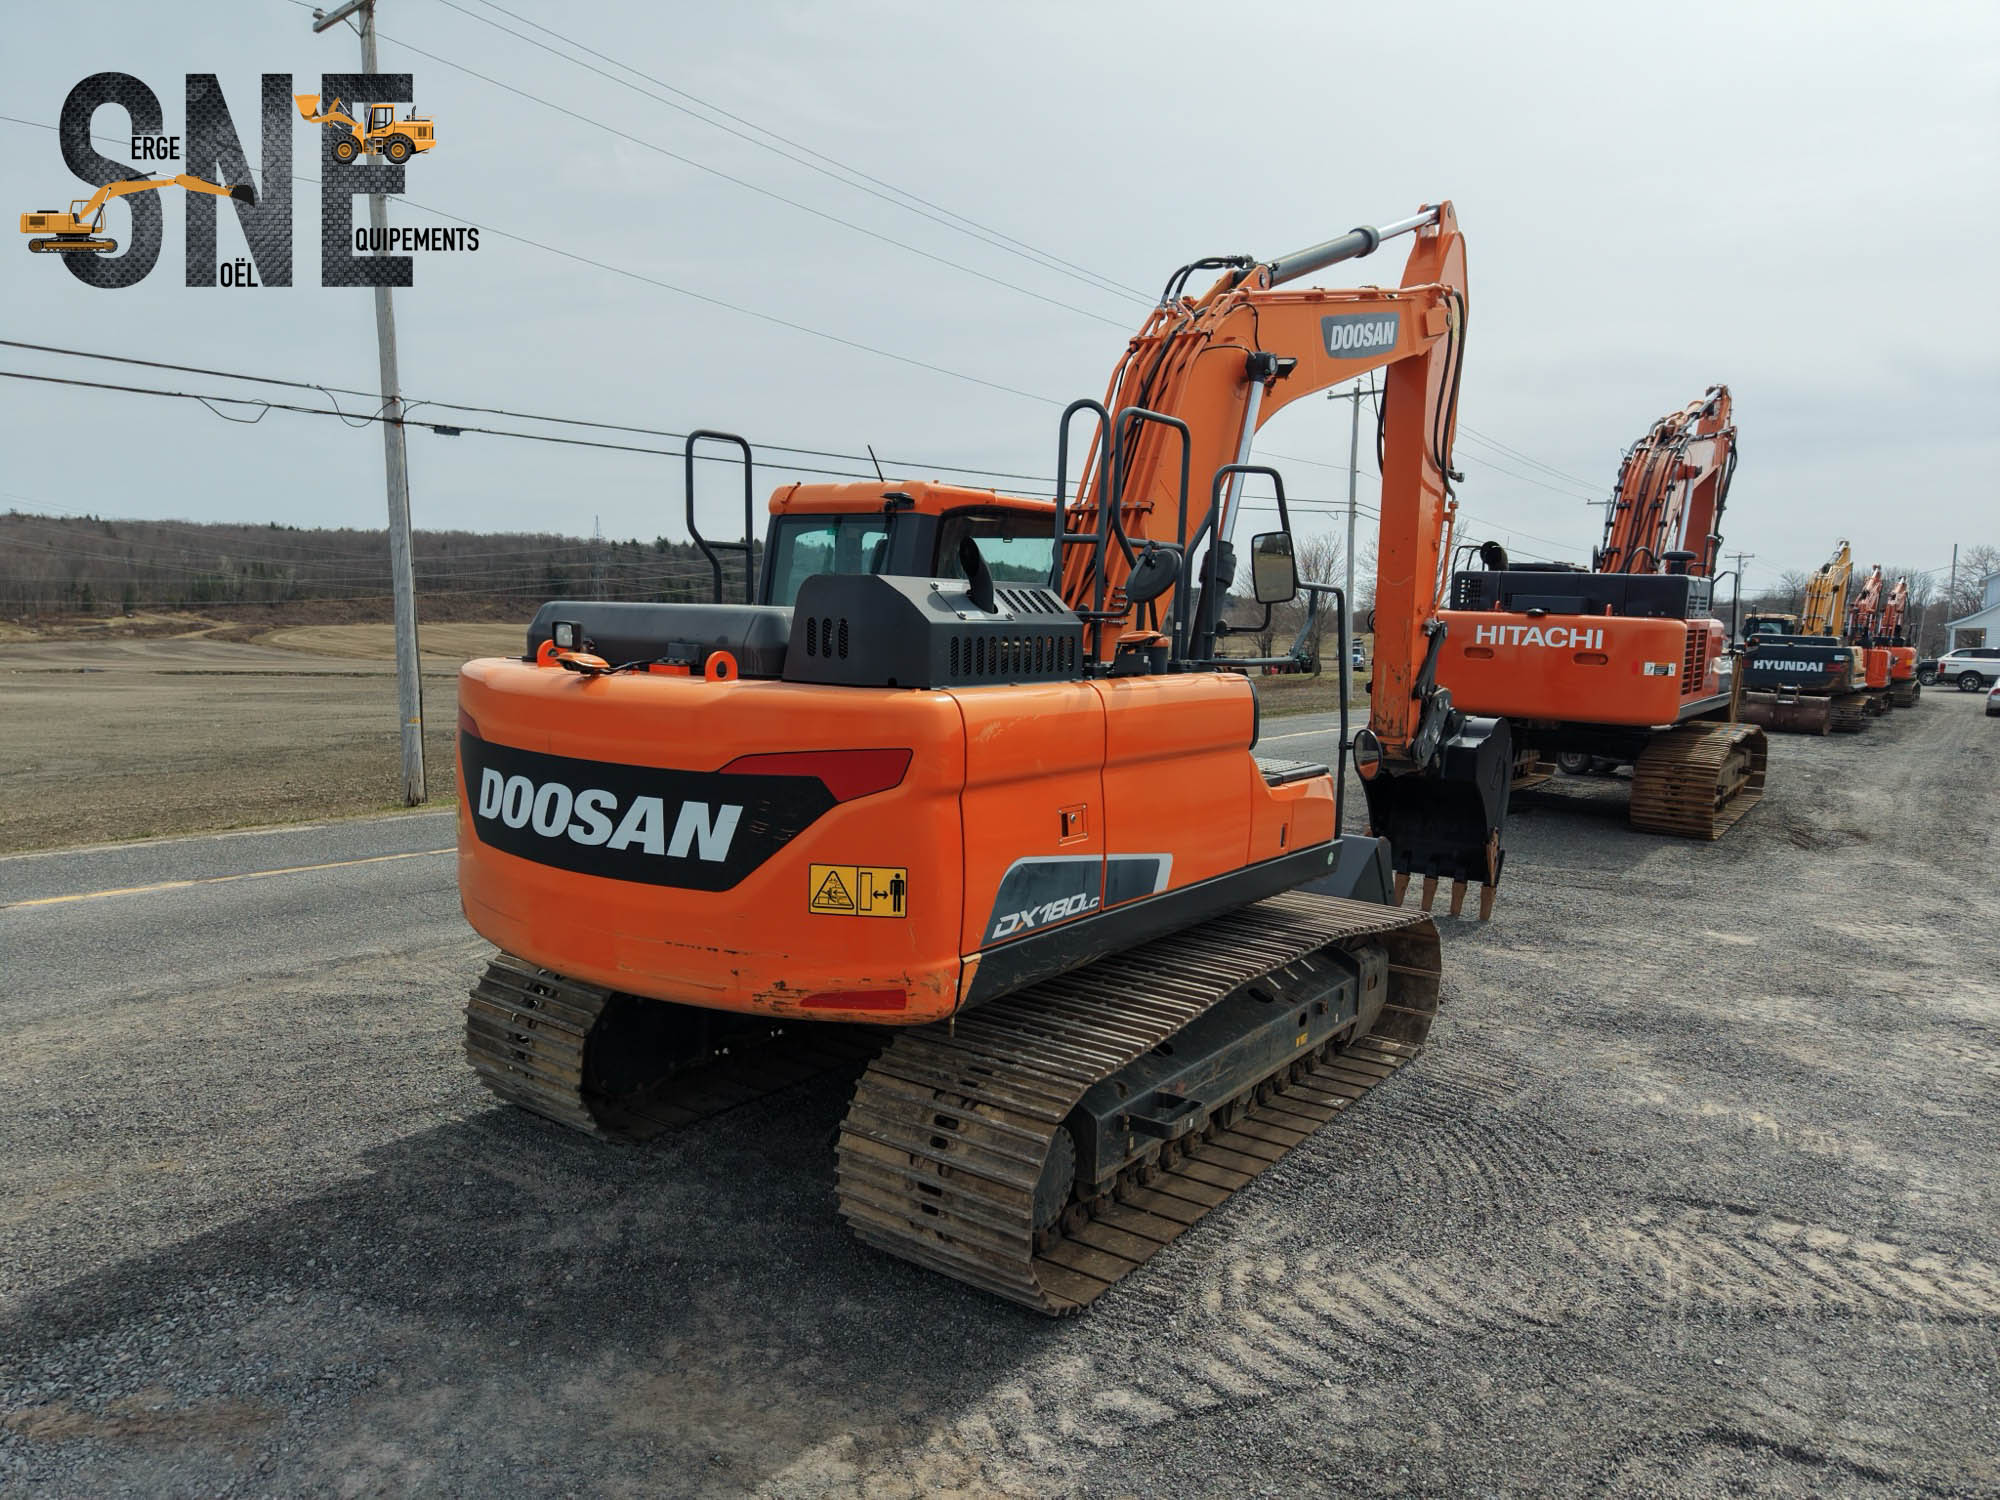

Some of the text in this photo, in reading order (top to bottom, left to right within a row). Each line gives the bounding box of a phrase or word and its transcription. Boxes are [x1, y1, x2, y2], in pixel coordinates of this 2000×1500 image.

[1330, 320, 1396, 351] DOOSAN
[1475, 623, 1604, 650] HITACHI
[1752, 658, 1824, 673] HYUNDAI
[478, 767, 744, 863] DOOSAN
